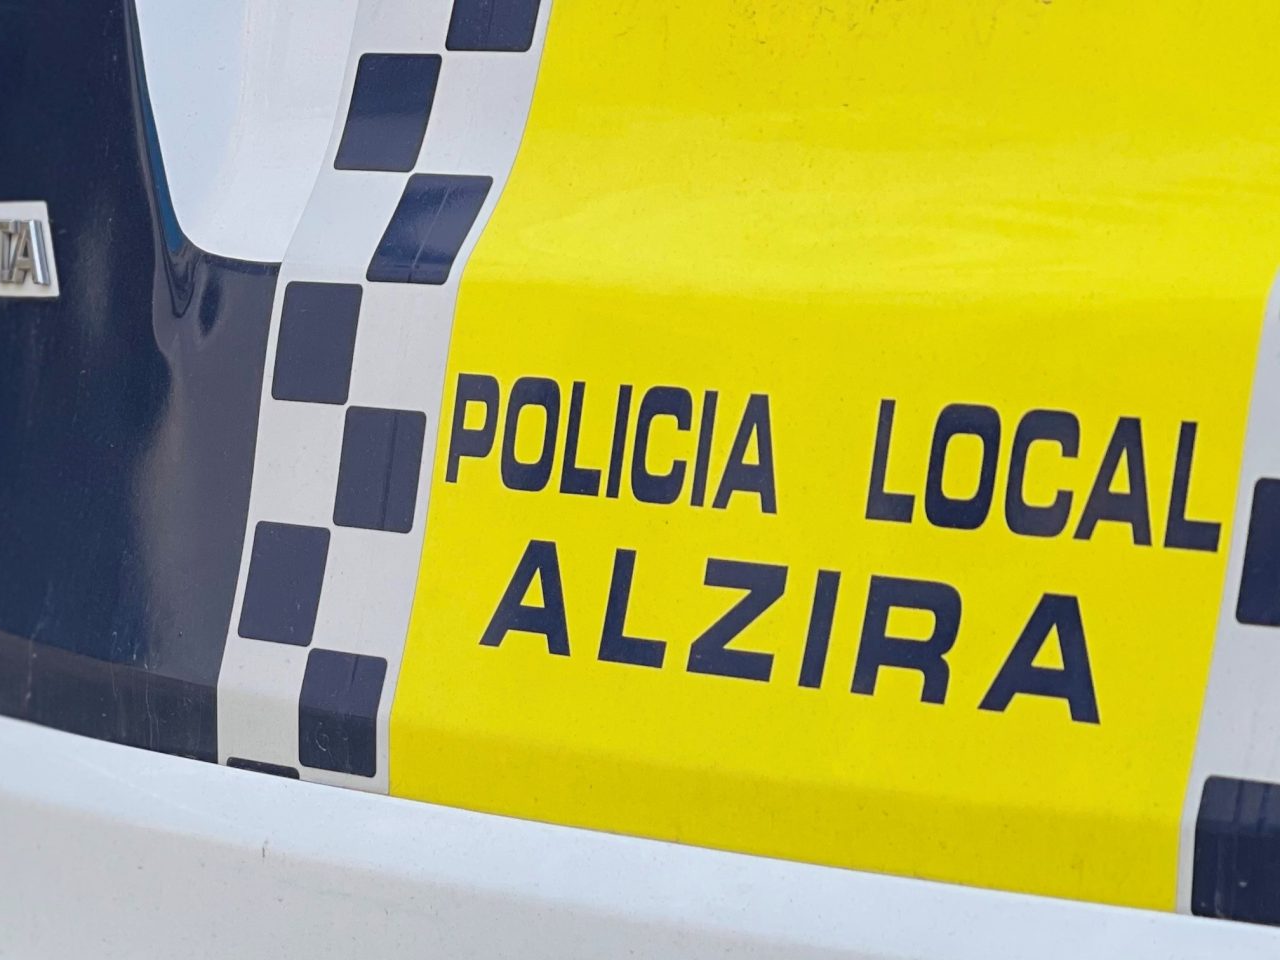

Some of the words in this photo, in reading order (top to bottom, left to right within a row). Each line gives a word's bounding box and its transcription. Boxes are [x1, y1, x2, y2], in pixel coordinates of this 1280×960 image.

[446, 373, 777, 514] POLICIA
[866, 399, 1223, 553] LOCAL
[479, 539, 1101, 725] ALZIRA
